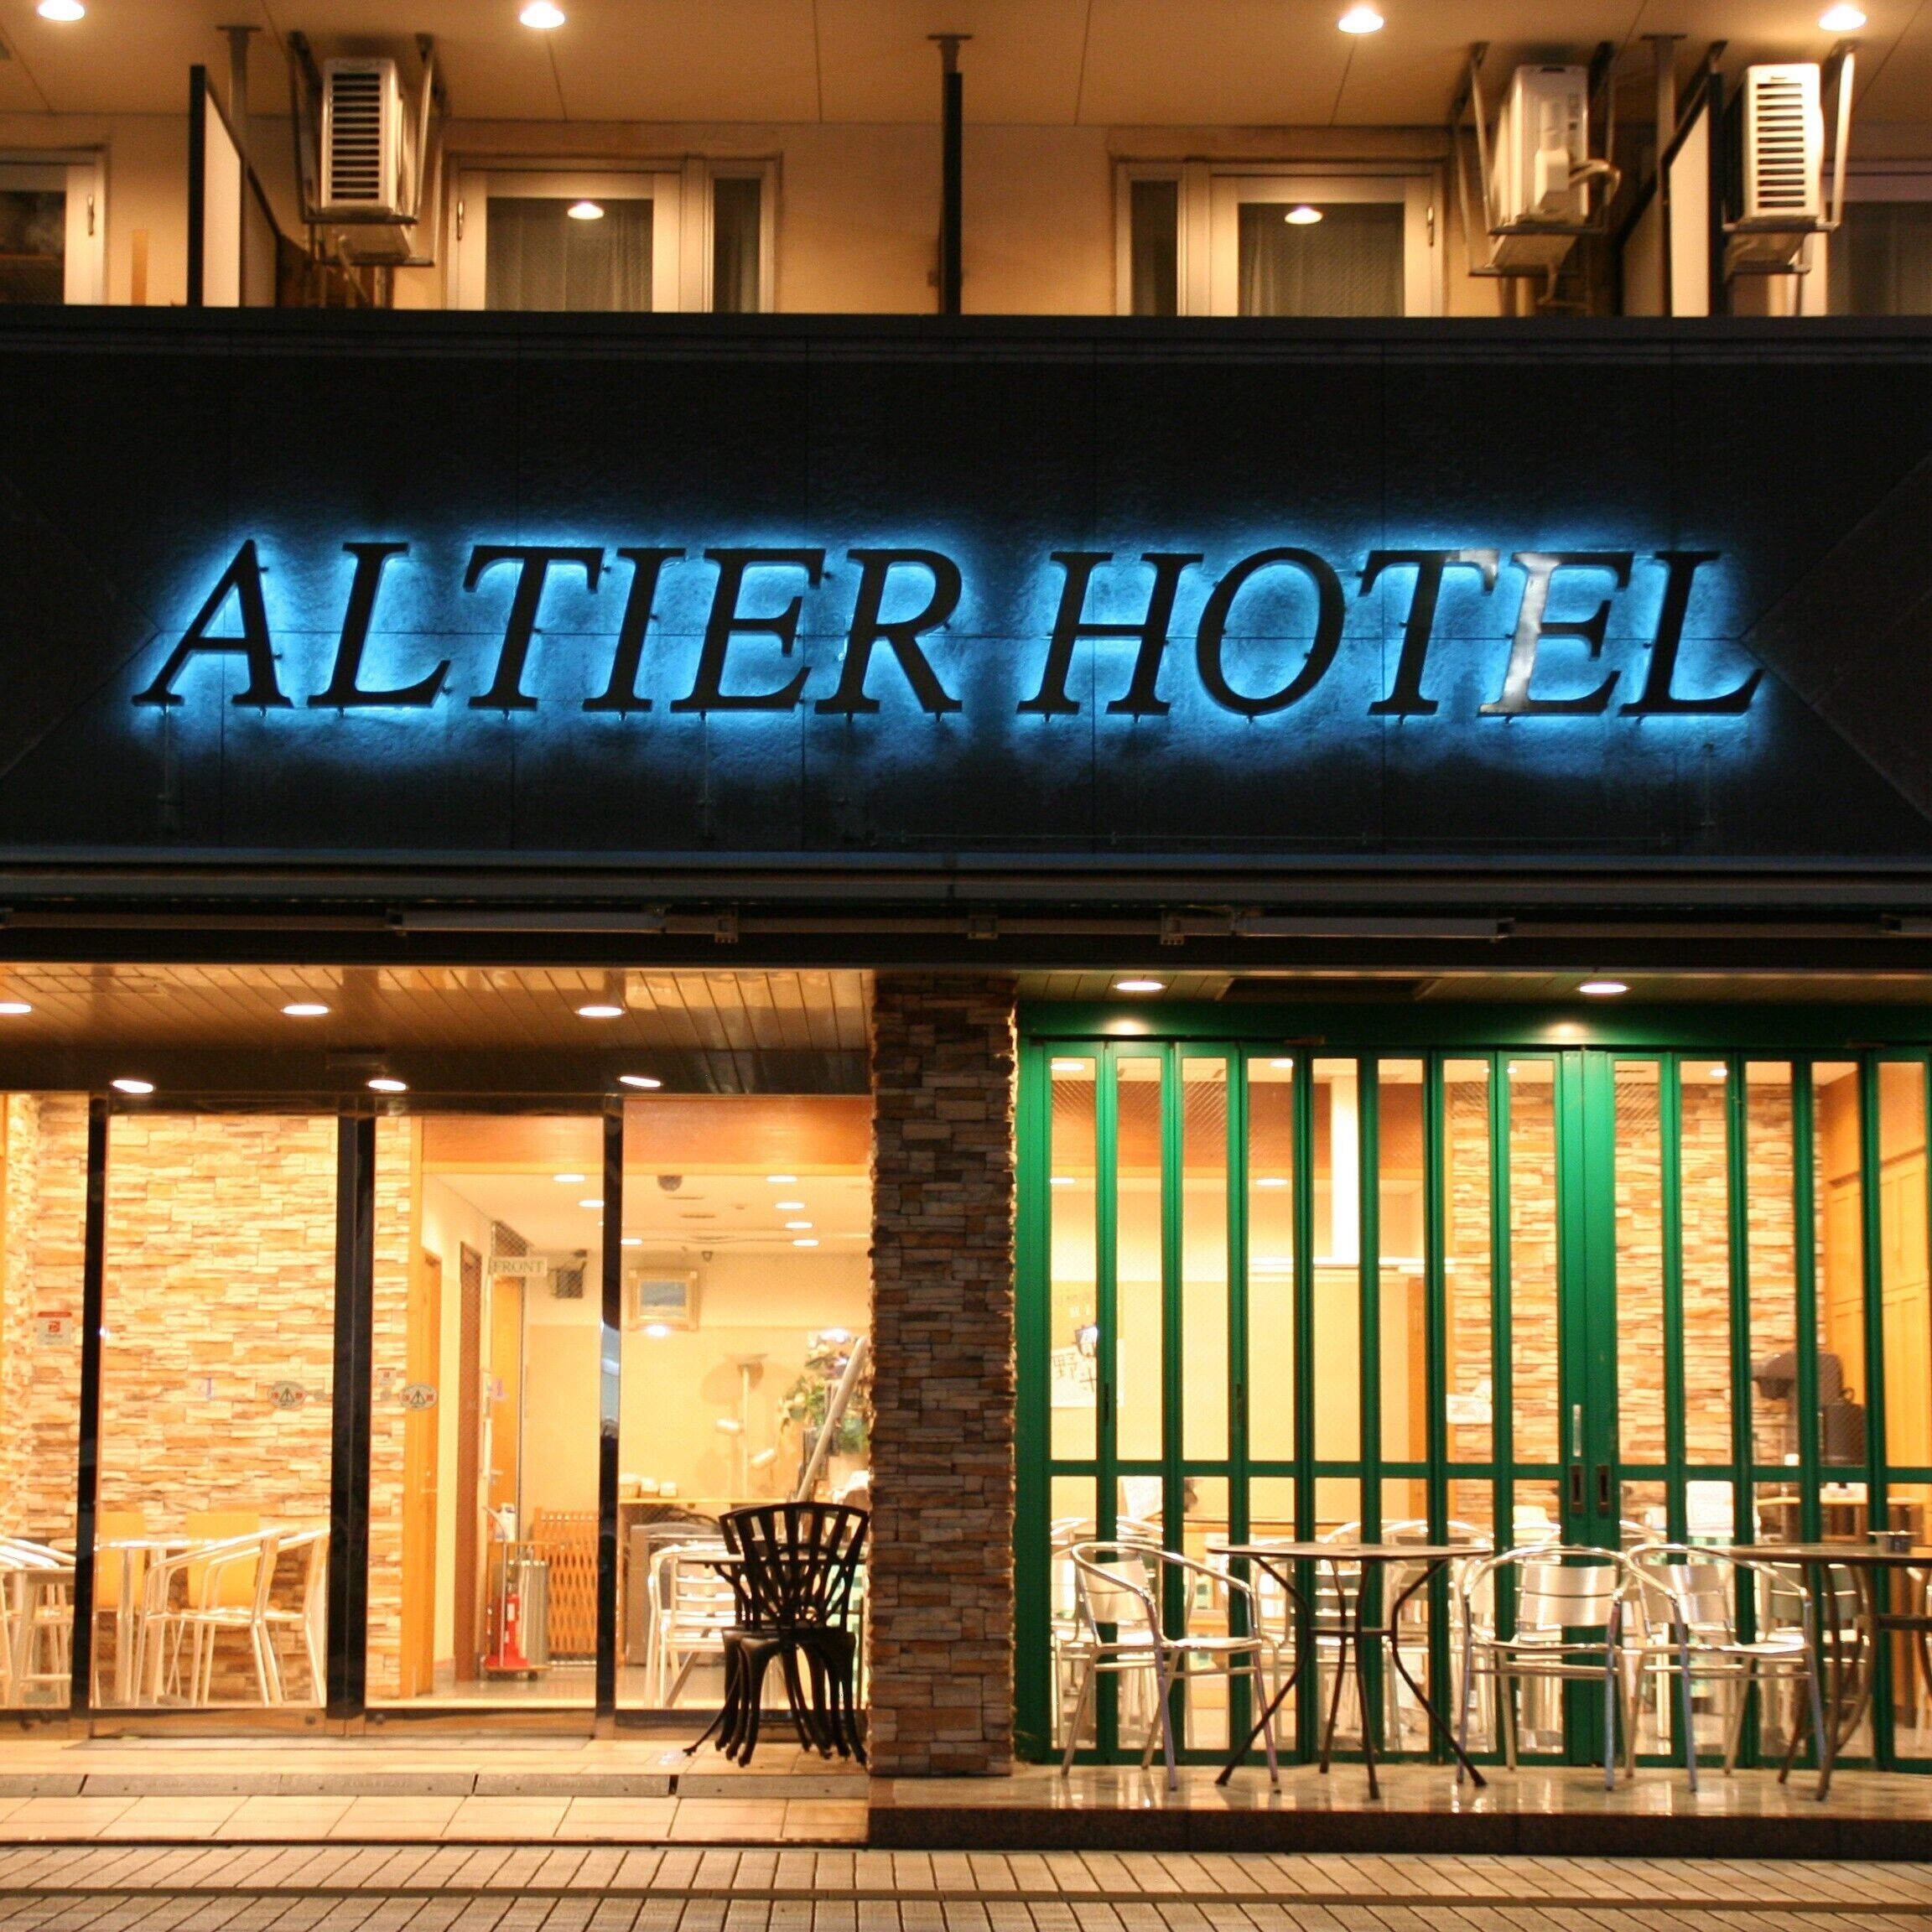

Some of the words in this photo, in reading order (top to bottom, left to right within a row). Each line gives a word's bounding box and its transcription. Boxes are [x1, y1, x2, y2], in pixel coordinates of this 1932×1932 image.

[132, 539, 963, 713] ALTIER
[1015, 547, 1764, 717] HOTEL
[492, 1260, 544, 1273] FRONT
